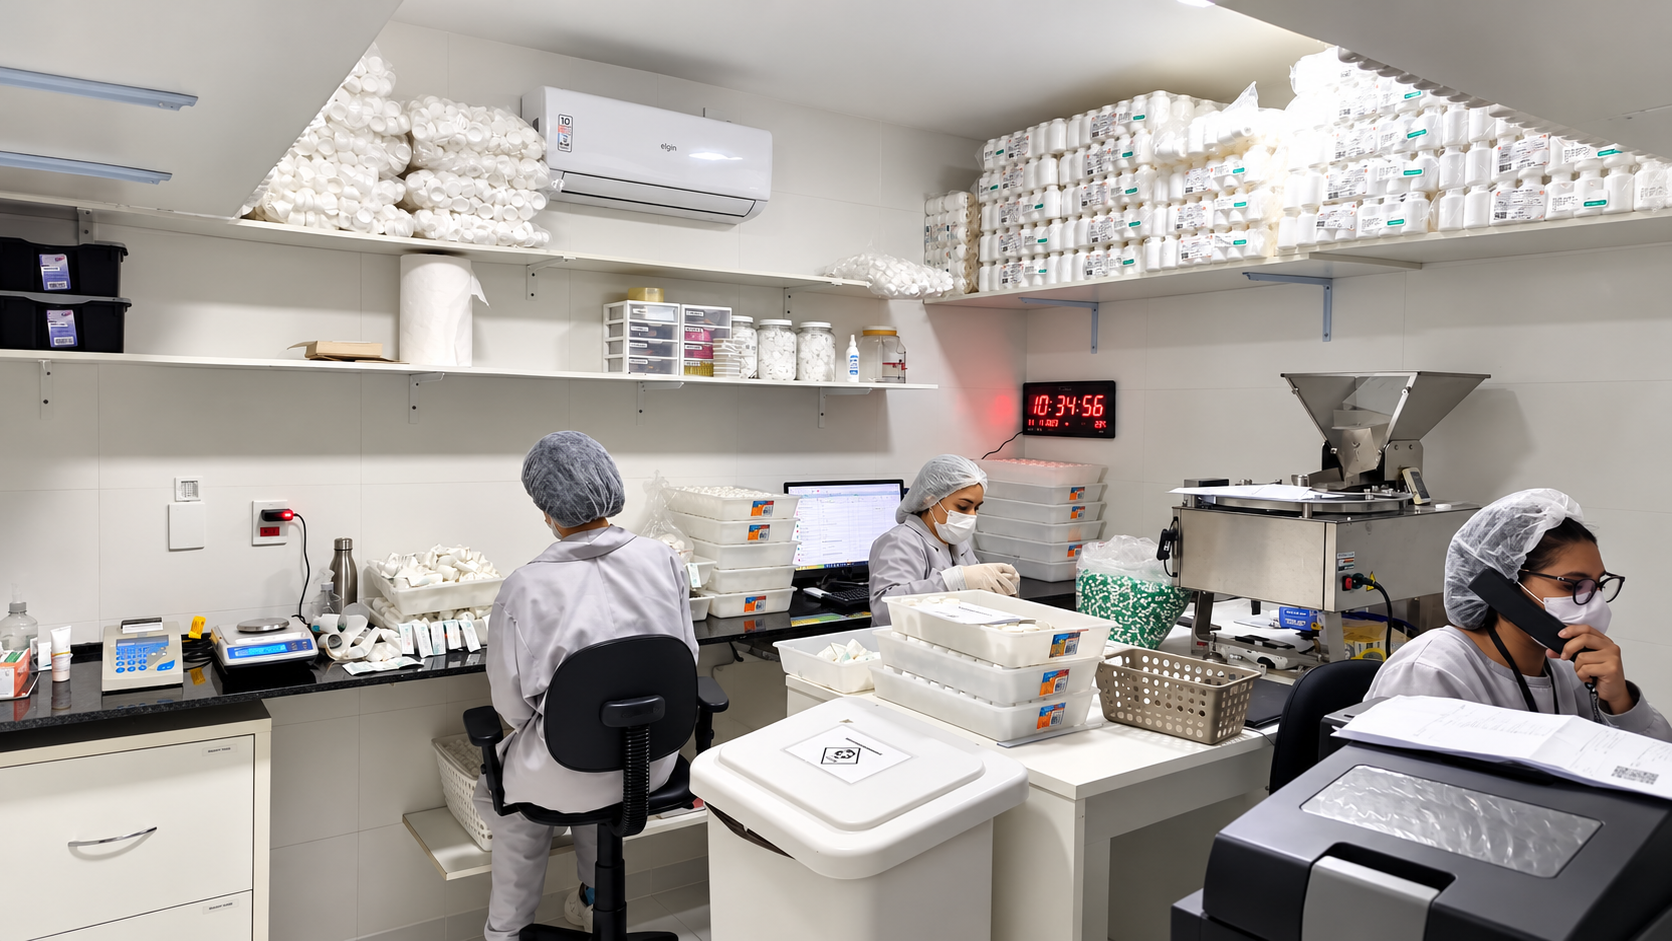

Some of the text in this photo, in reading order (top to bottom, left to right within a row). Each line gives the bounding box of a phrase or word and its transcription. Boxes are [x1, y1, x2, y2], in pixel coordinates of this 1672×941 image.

[560, 116, 570, 126] 10
[660, 142, 677, 152] elgin
[1033, 394, 1104, 416] 10:34:56
